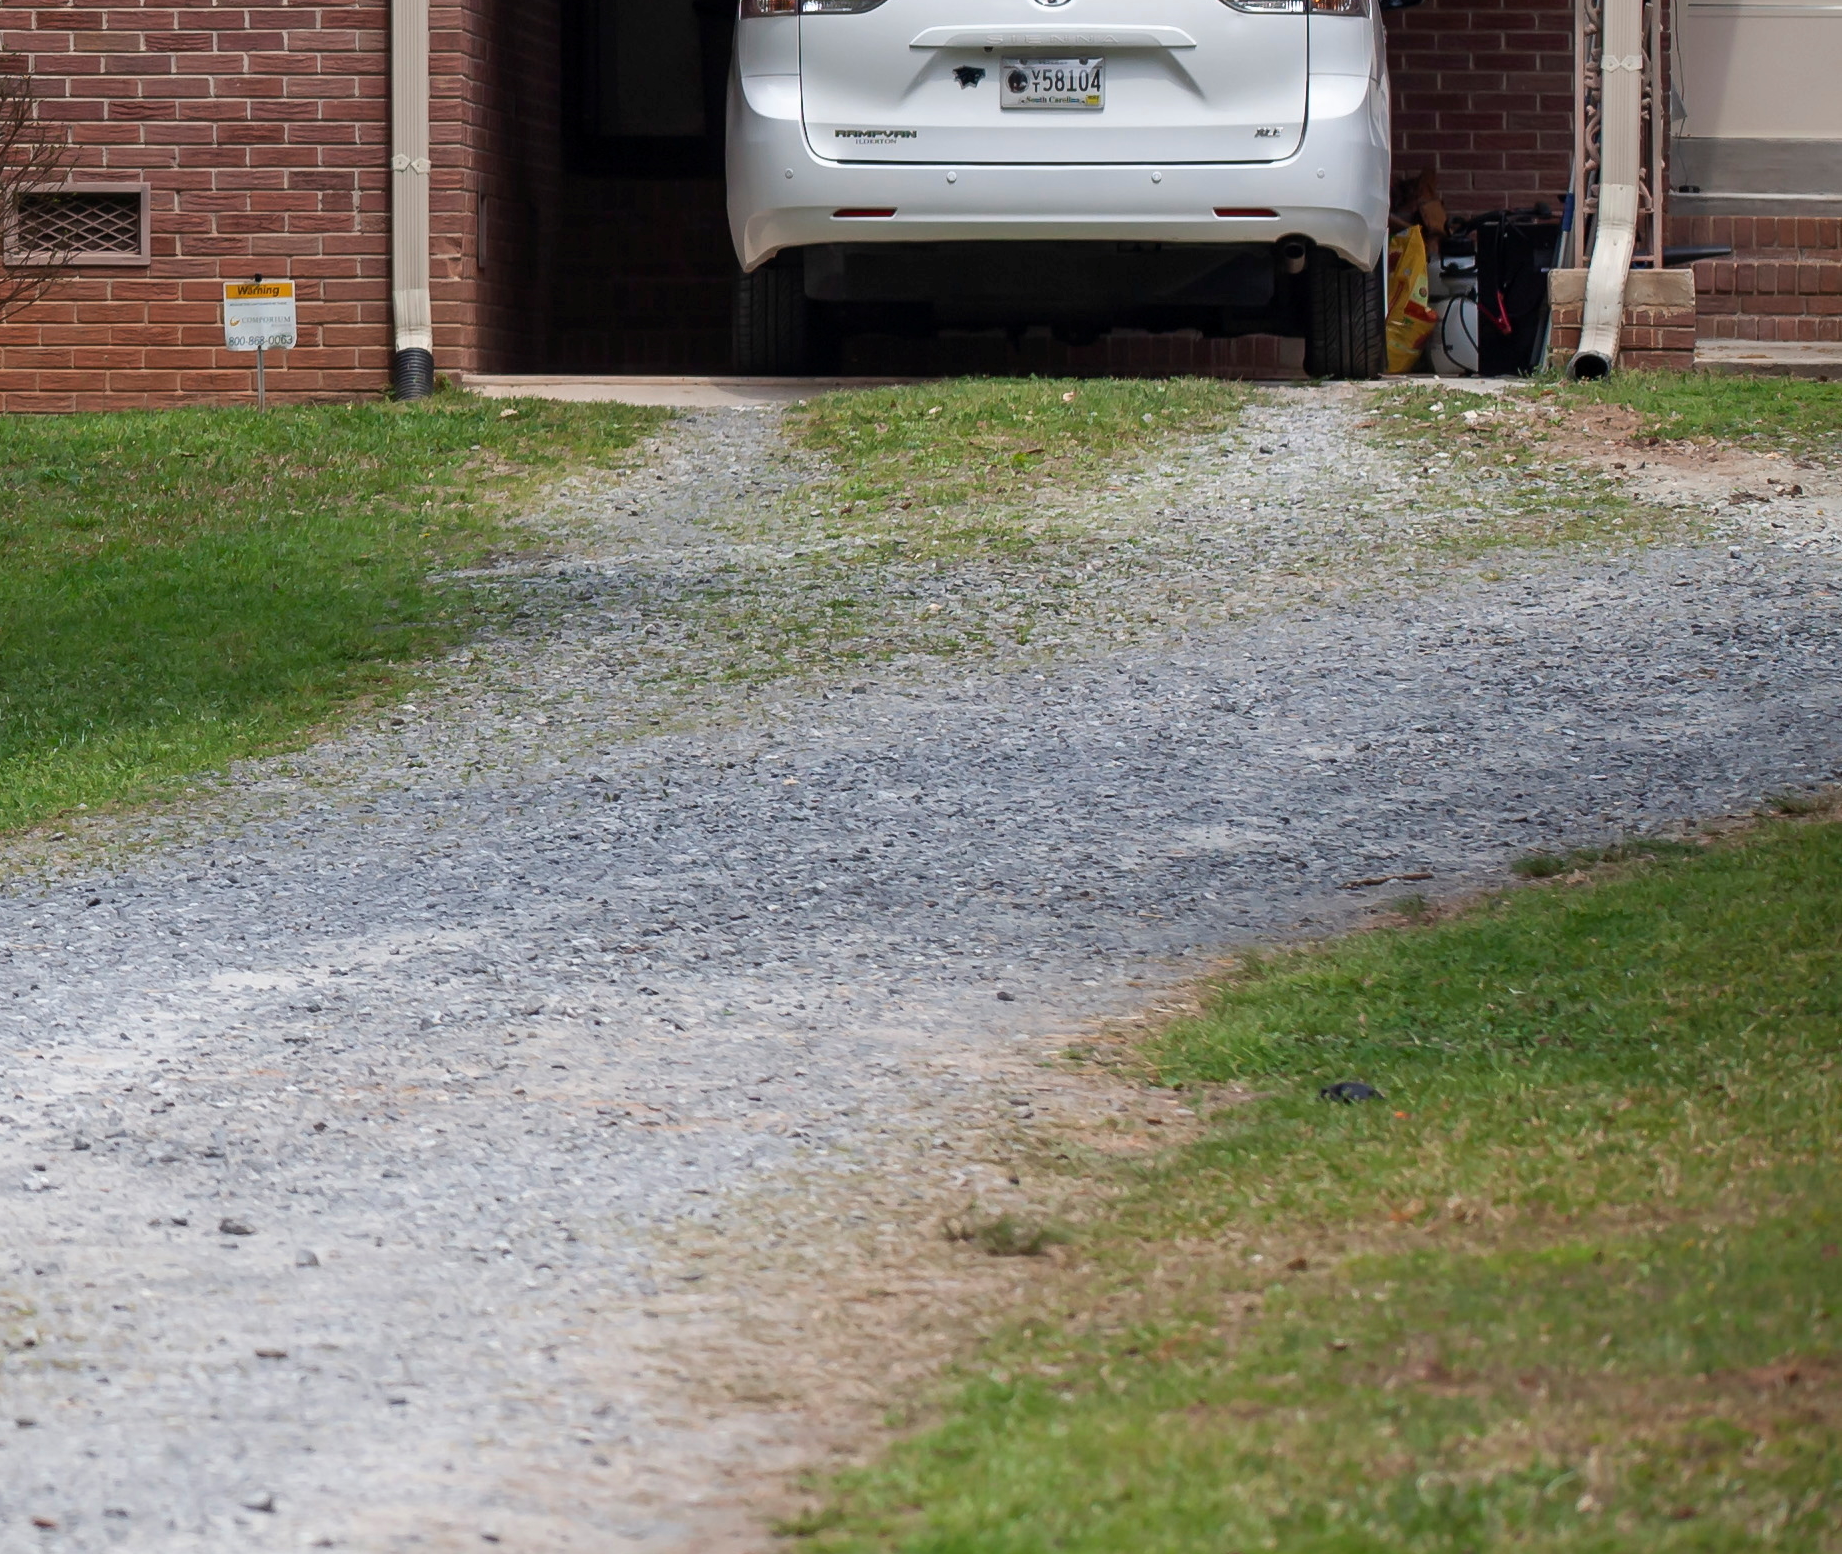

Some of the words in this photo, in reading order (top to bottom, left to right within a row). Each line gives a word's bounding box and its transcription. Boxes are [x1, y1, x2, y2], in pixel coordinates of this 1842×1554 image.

[985, 34, 1120, 44] SIENNA
[1042, 68, 1102, 93] 58104
[237, 286, 280, 297] Warning
